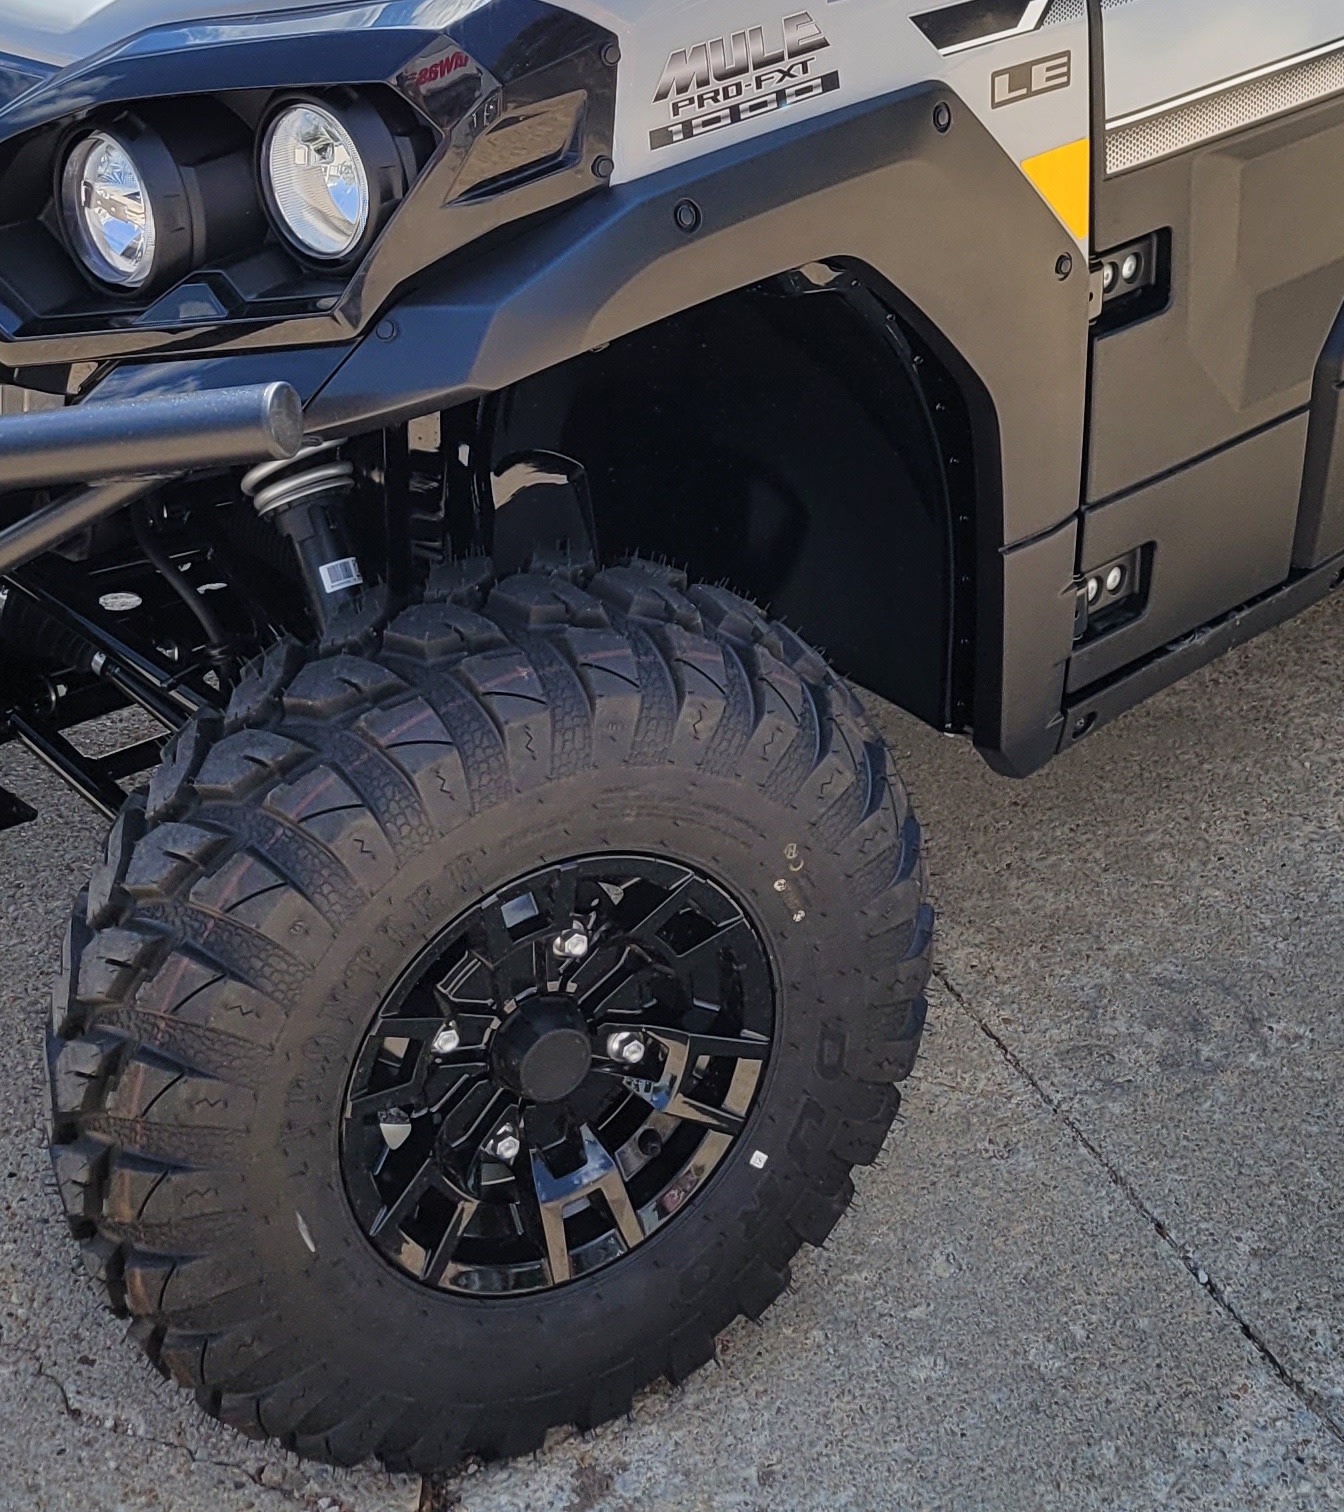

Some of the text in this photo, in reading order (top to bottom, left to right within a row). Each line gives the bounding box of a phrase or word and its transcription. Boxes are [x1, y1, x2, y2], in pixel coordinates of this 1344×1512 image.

[652, 10, 831, 103] MULE
[670, 56, 817, 119] PRO-FXT
[994, 54, 1068, 104] LE
[667, 77, 824, 142] 1000
